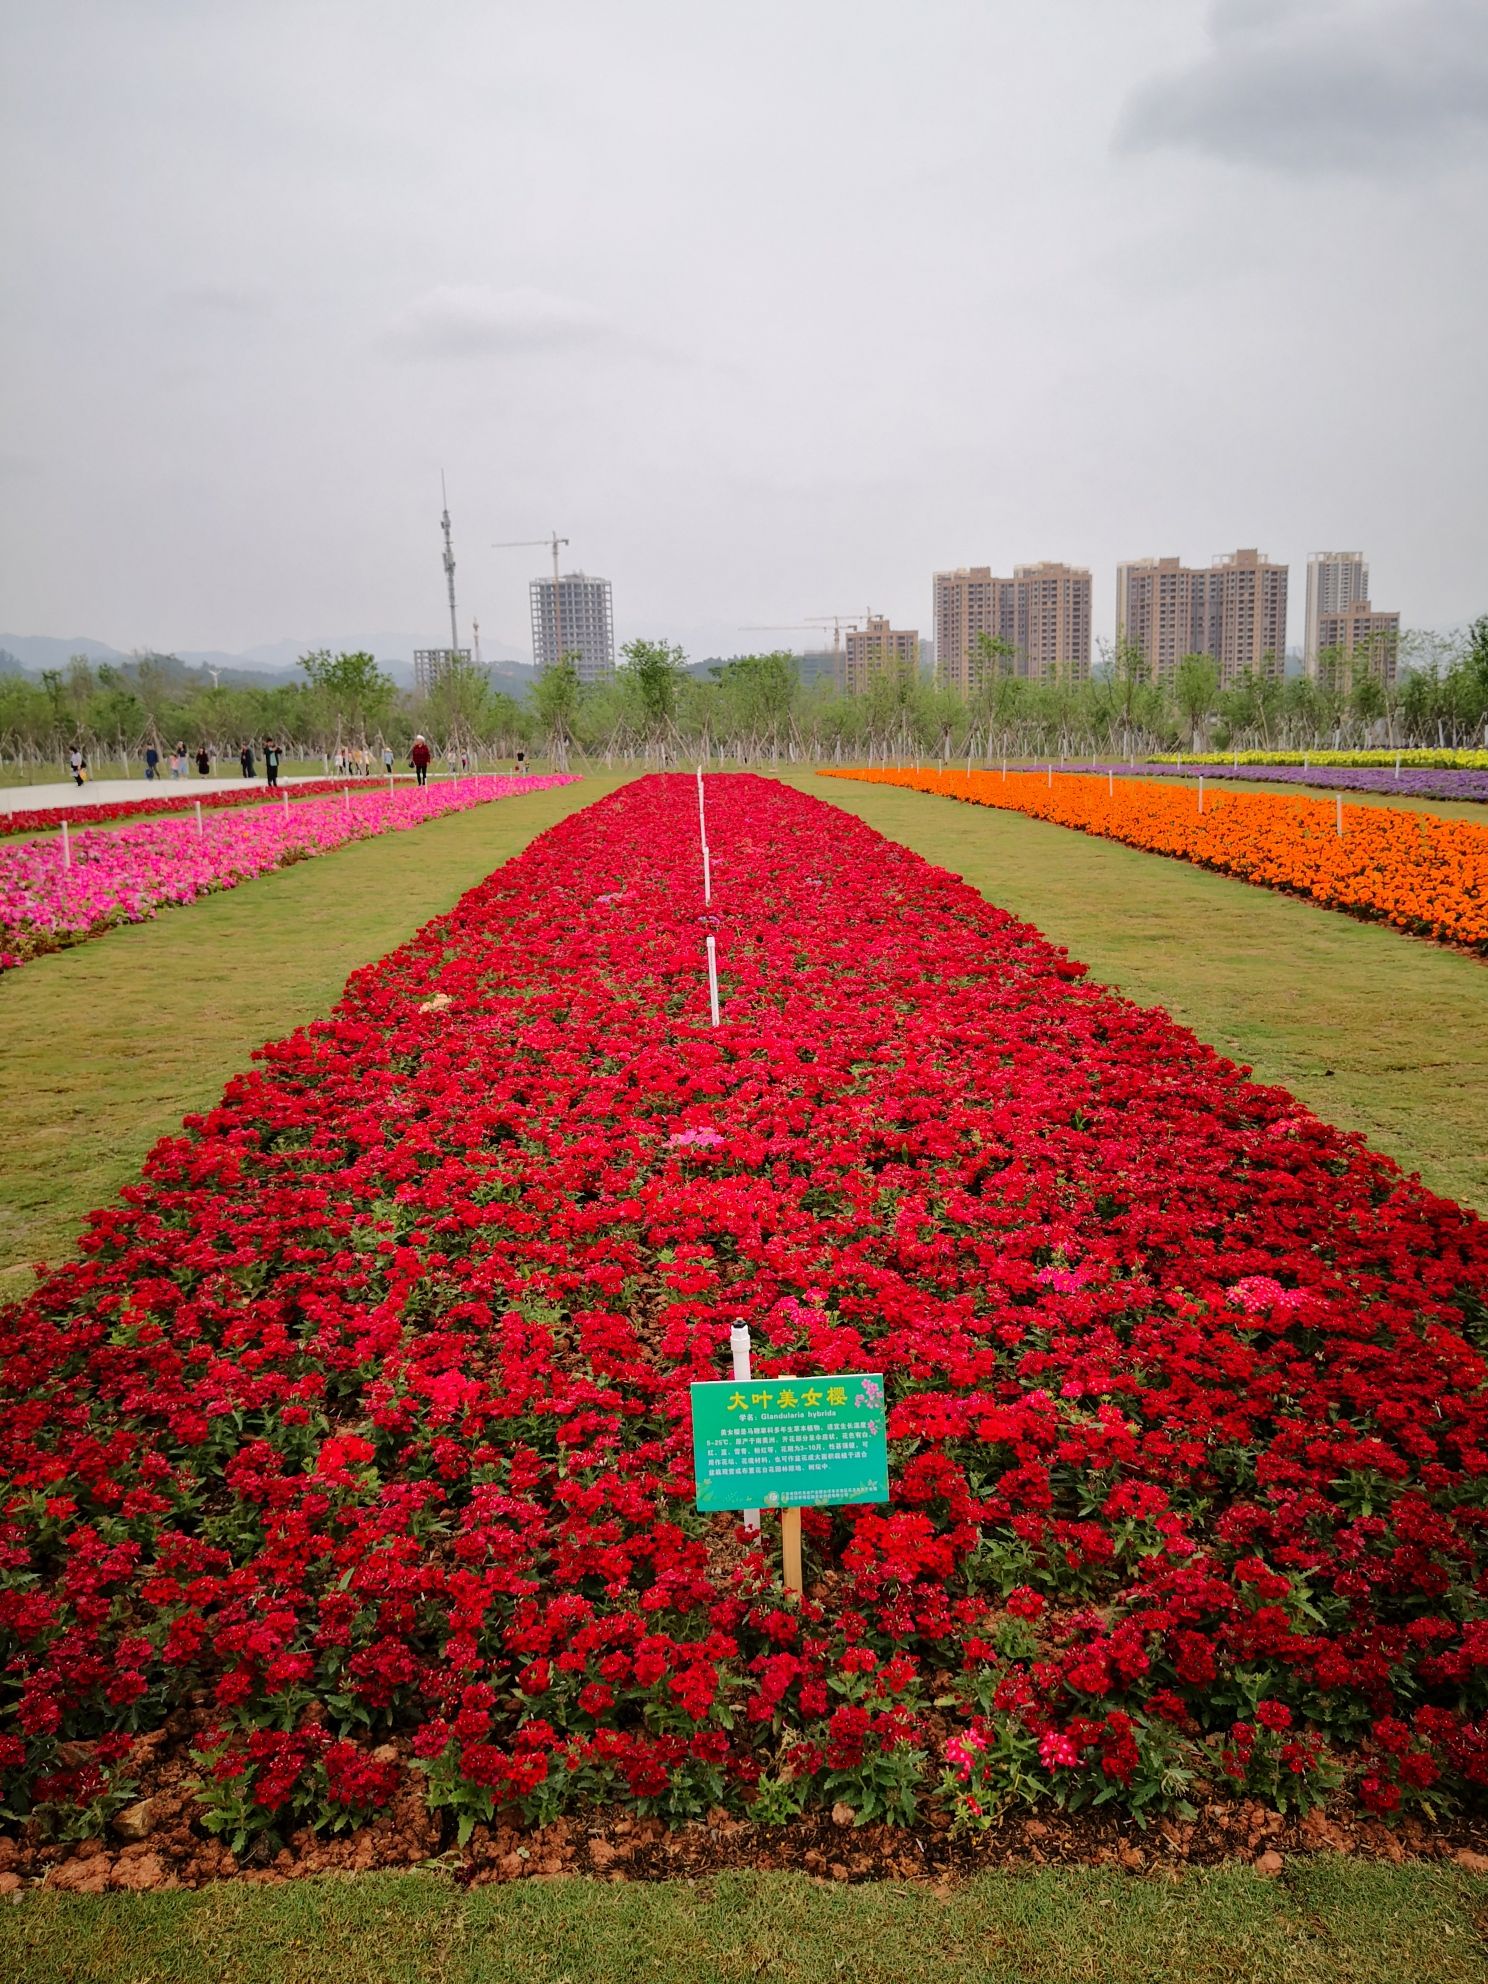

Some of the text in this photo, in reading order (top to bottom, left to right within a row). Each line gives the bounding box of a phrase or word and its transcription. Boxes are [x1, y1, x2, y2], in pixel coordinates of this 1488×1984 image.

[727, 1386, 848, 1411] 大叶美女樱
[761, 1411, 804, 1420] Glandularia
[807, 1410, 836, 1419] hybrida
